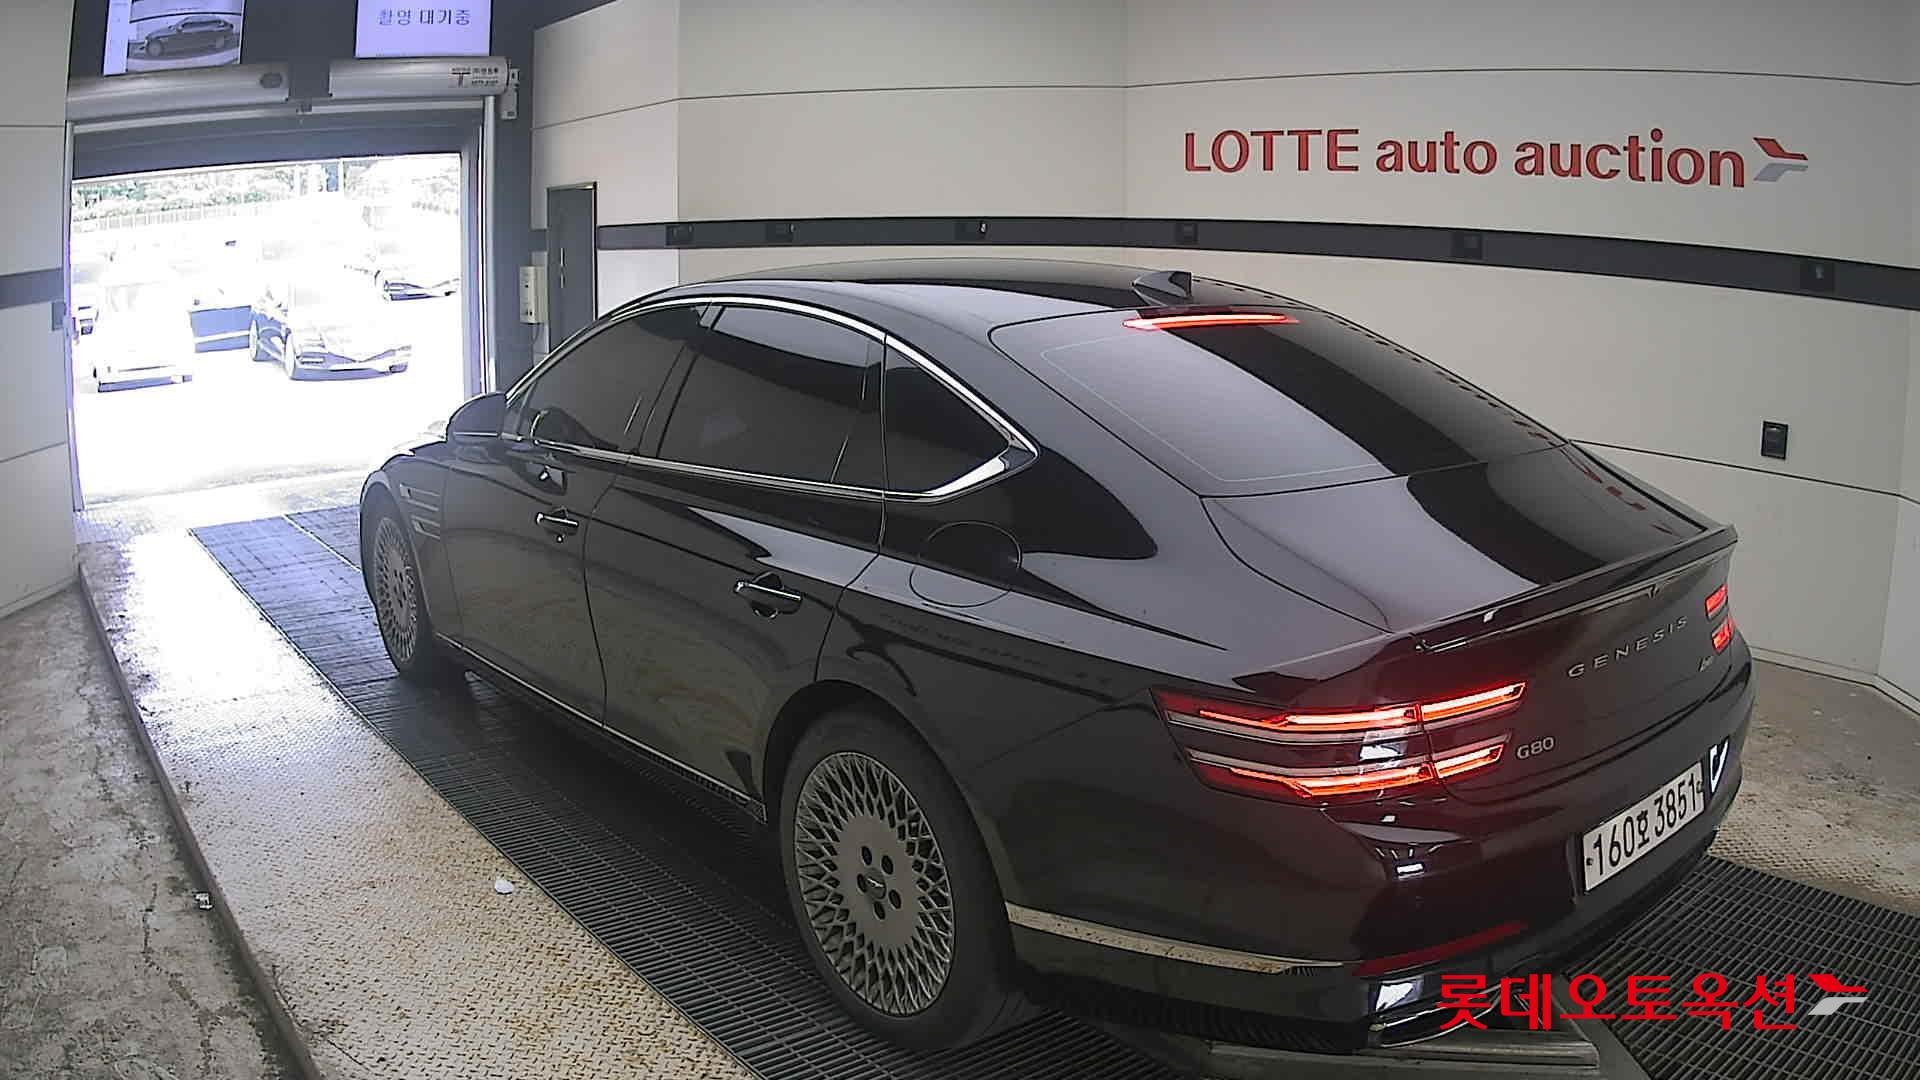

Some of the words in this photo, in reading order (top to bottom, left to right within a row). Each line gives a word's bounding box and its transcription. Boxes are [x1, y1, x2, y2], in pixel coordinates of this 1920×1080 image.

[420, 8, 470, 26] 대기중
[1184, 128, 1360, 174] LOTTE
[1375, 130, 1498, 176] auto
[1513, 128, 1746, 189] auction
[1567, 615, 1690, 679] GENESIS
[1515, 735, 1556, 761] G80
[1653, 772, 1697, 838] 3851
